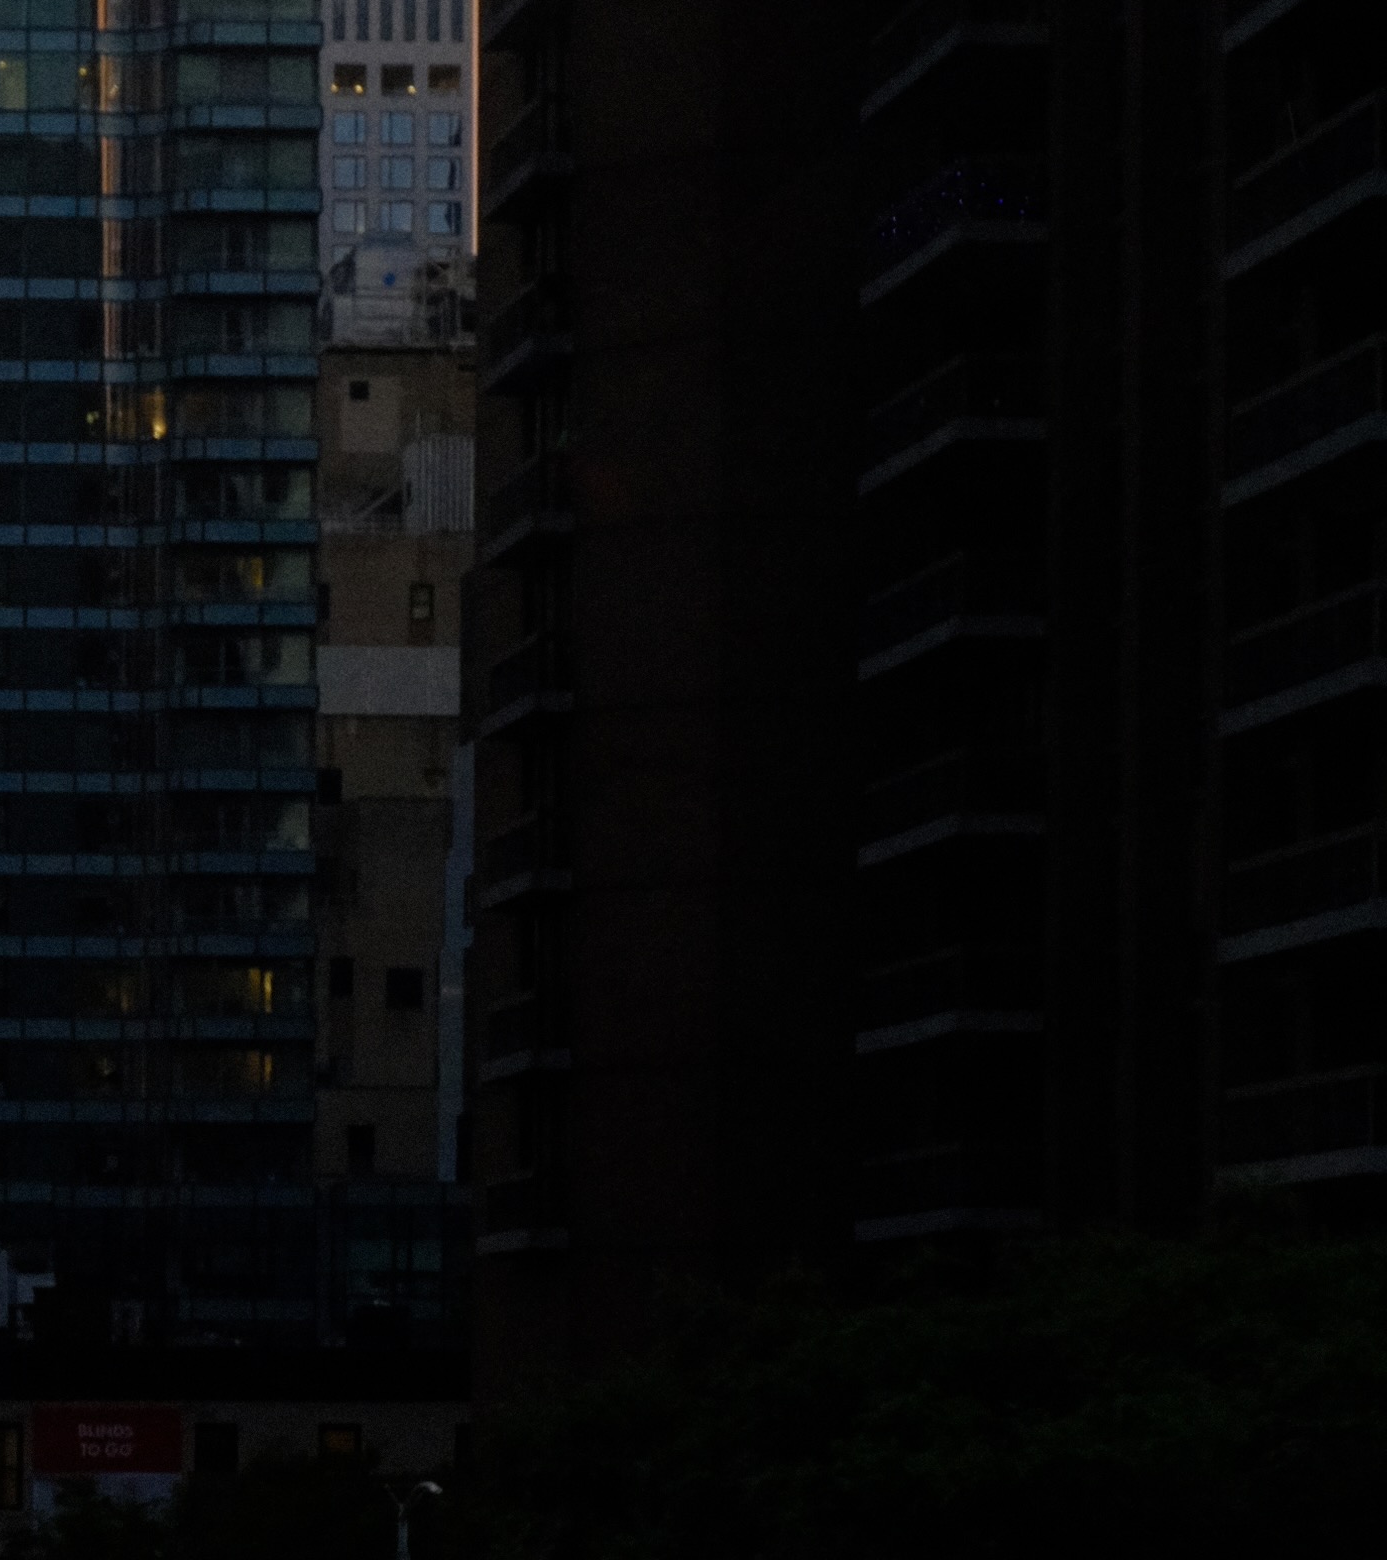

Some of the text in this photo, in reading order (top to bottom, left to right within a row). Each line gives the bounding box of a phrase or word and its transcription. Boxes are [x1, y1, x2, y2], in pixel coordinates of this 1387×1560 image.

[77, 1423, 133, 1438] BLINDS
[80, 1442, 133, 1458] TO GO
